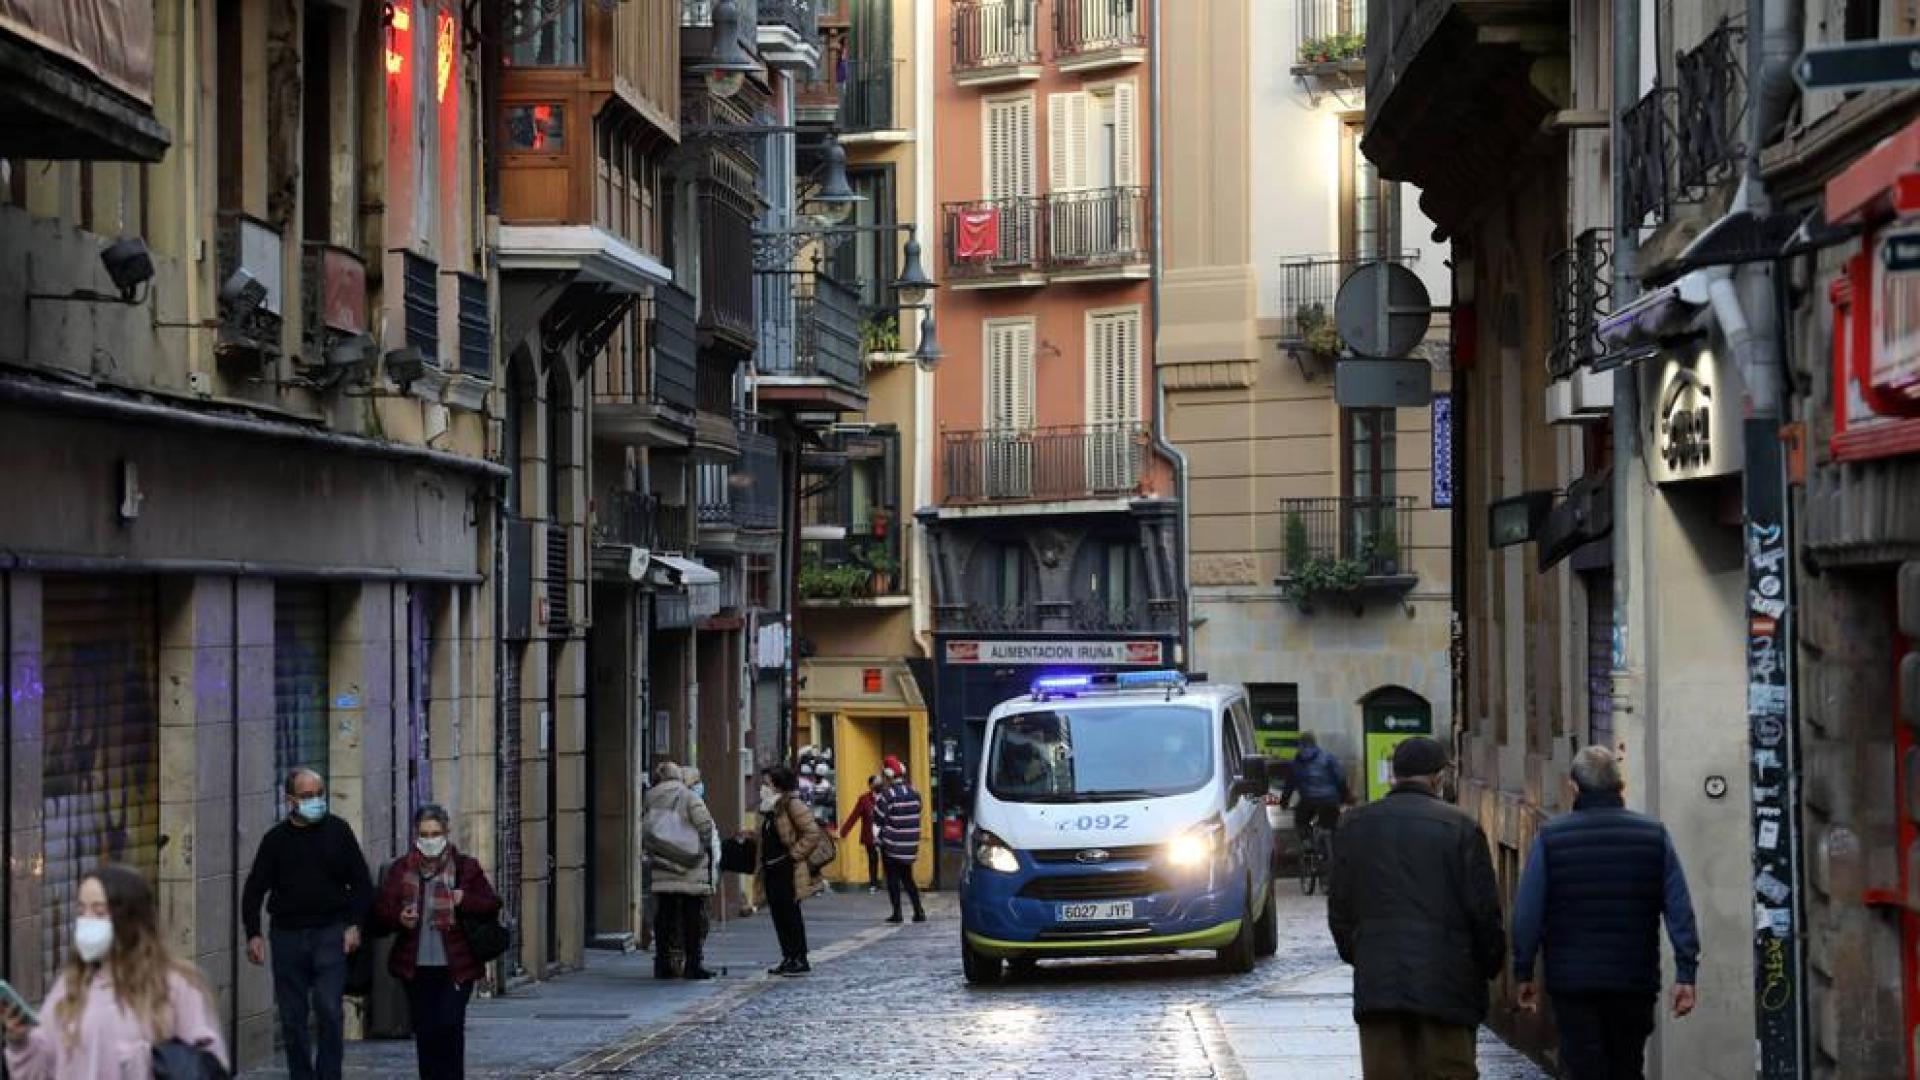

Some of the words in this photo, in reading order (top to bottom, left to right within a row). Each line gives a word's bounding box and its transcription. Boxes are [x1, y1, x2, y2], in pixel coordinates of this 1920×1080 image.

[1077, 814, 1129, 831] 092
[1065, 904, 1097, 919] 6027
[1105, 902, 1131, 918] JYF
